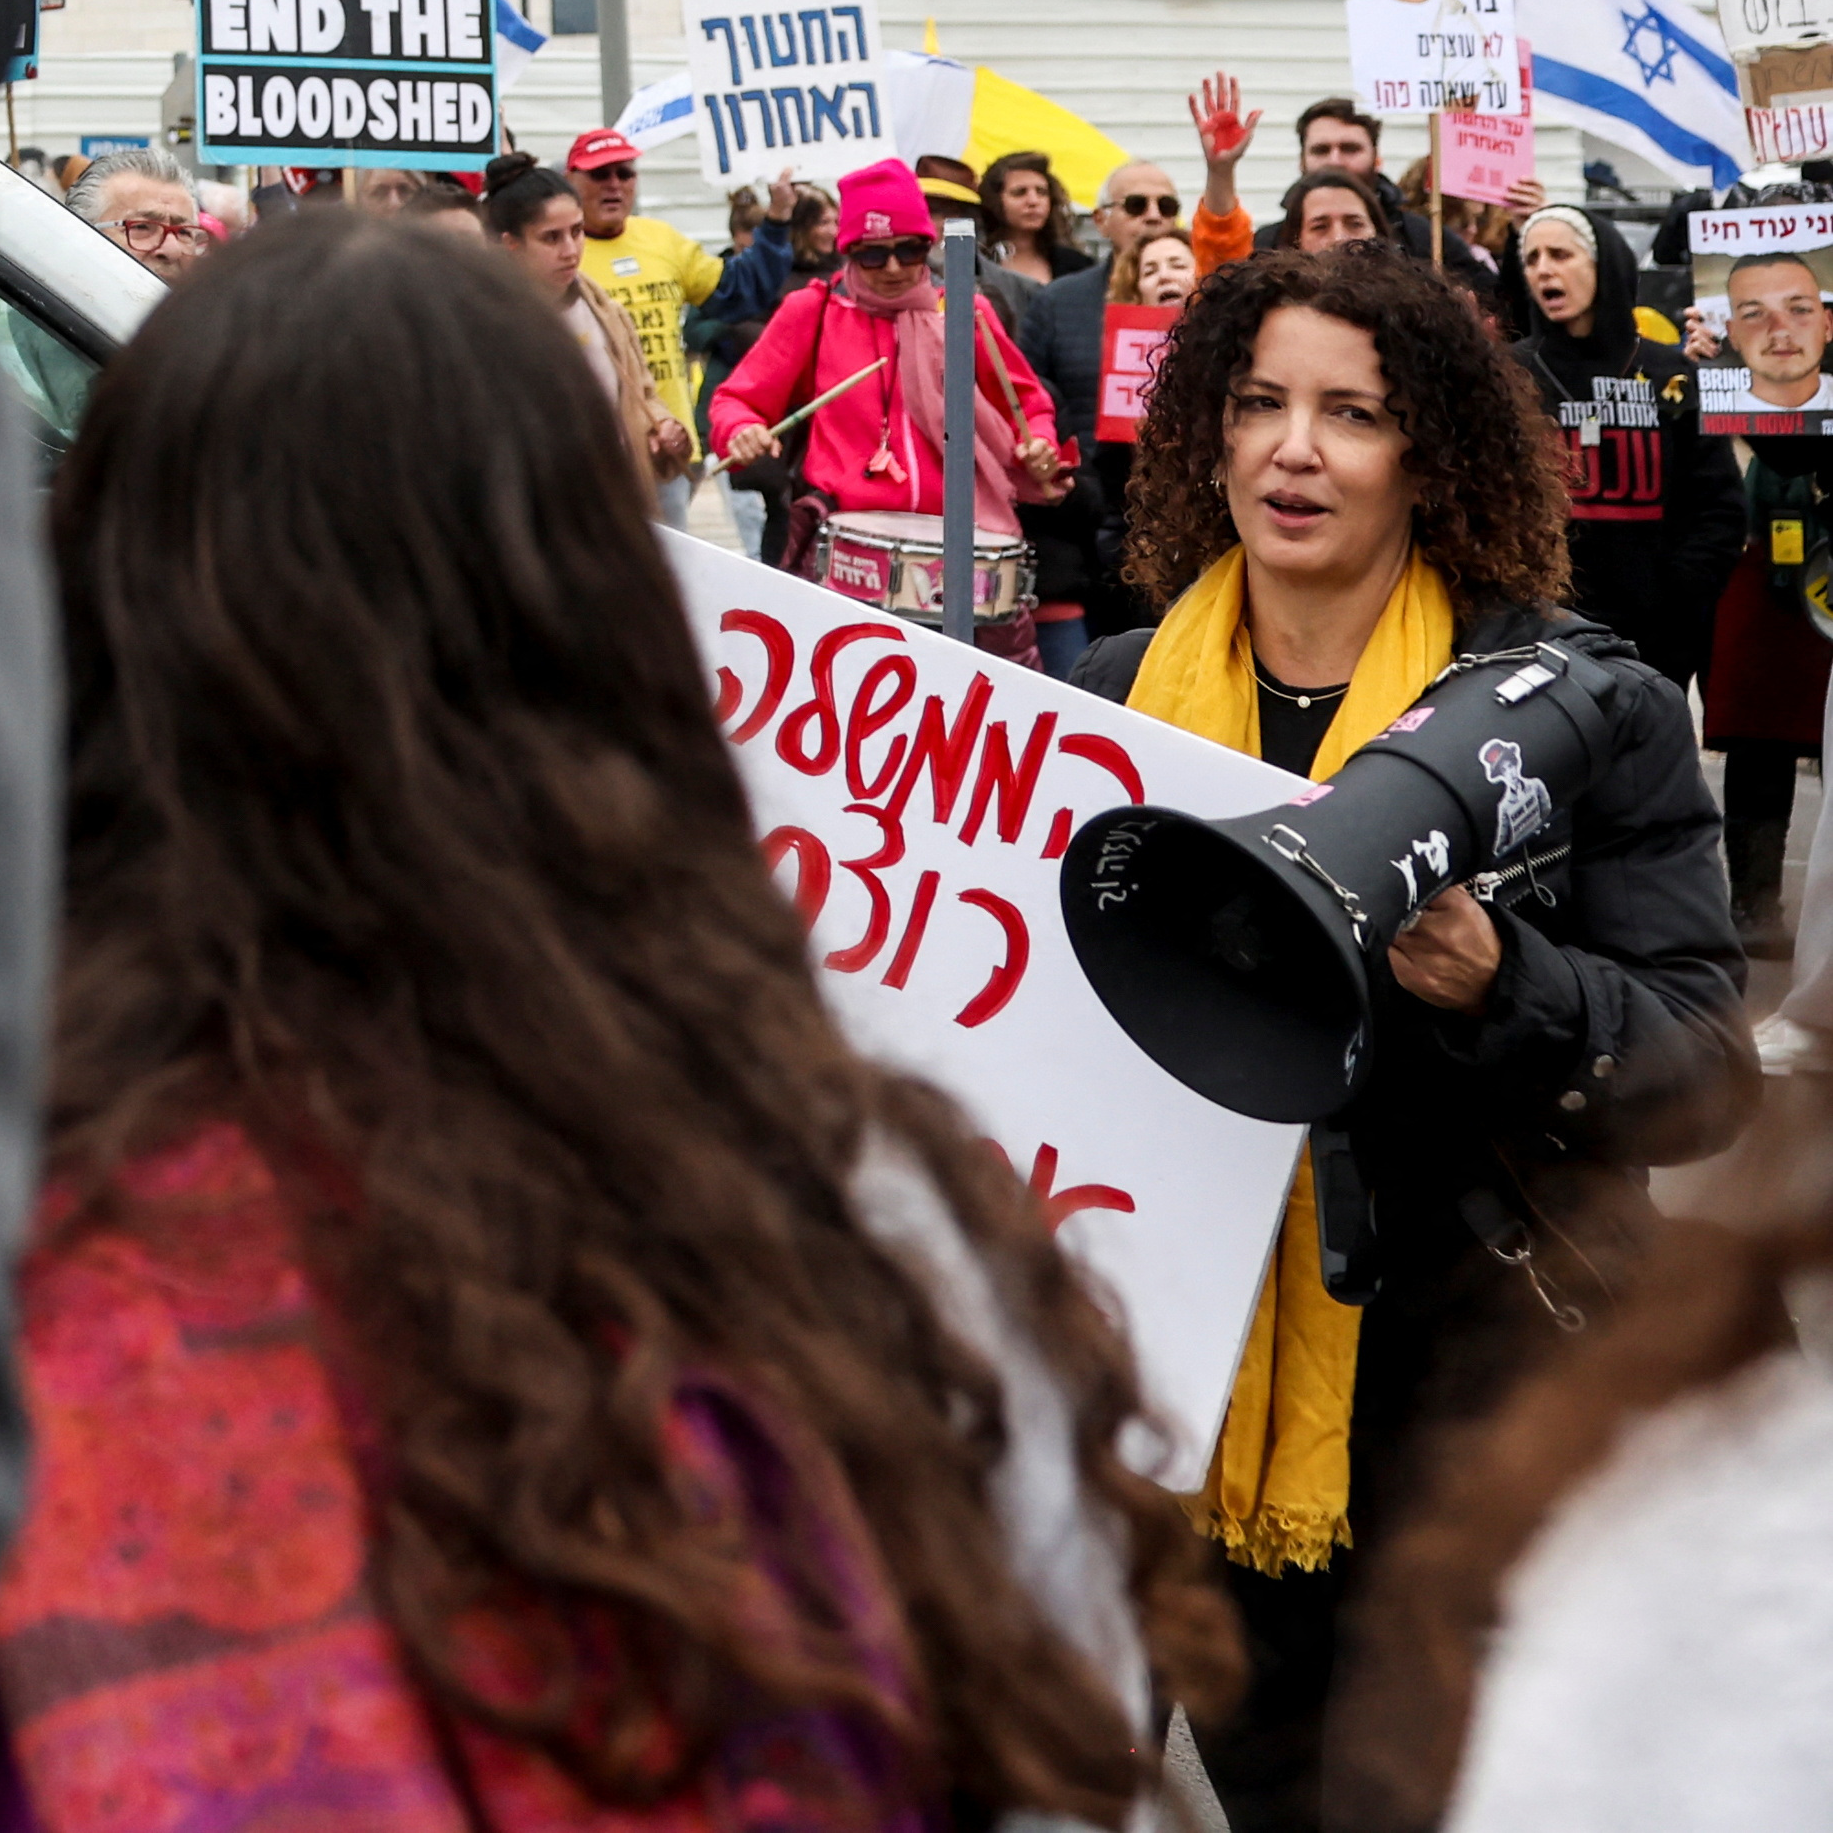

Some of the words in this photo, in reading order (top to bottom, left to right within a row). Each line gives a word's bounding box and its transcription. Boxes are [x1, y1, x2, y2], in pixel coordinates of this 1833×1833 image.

[701, 5, 869, 87] החטוף
[1418, 33, 1476, 58] עוצרים
[1483, 32, 1504, 58] לא
[1375, 80, 1411, 109] פה!
[1419, 80, 1476, 109] שאתה
[1483, 81, 1508, 109] עד
[204, 73, 493, 144] BLOODSHED
[704, 81, 881, 175] האחרון
[1700, 218, 1741, 242] חי!
[1748, 216, 1797, 240] עוד
[1696, 367, 1753, 391] BRING
[1699, 391, 1735, 413] HIM
[1703, 414, 1750, 435] HOME
[1754, 412, 1806, 435] NOW!
